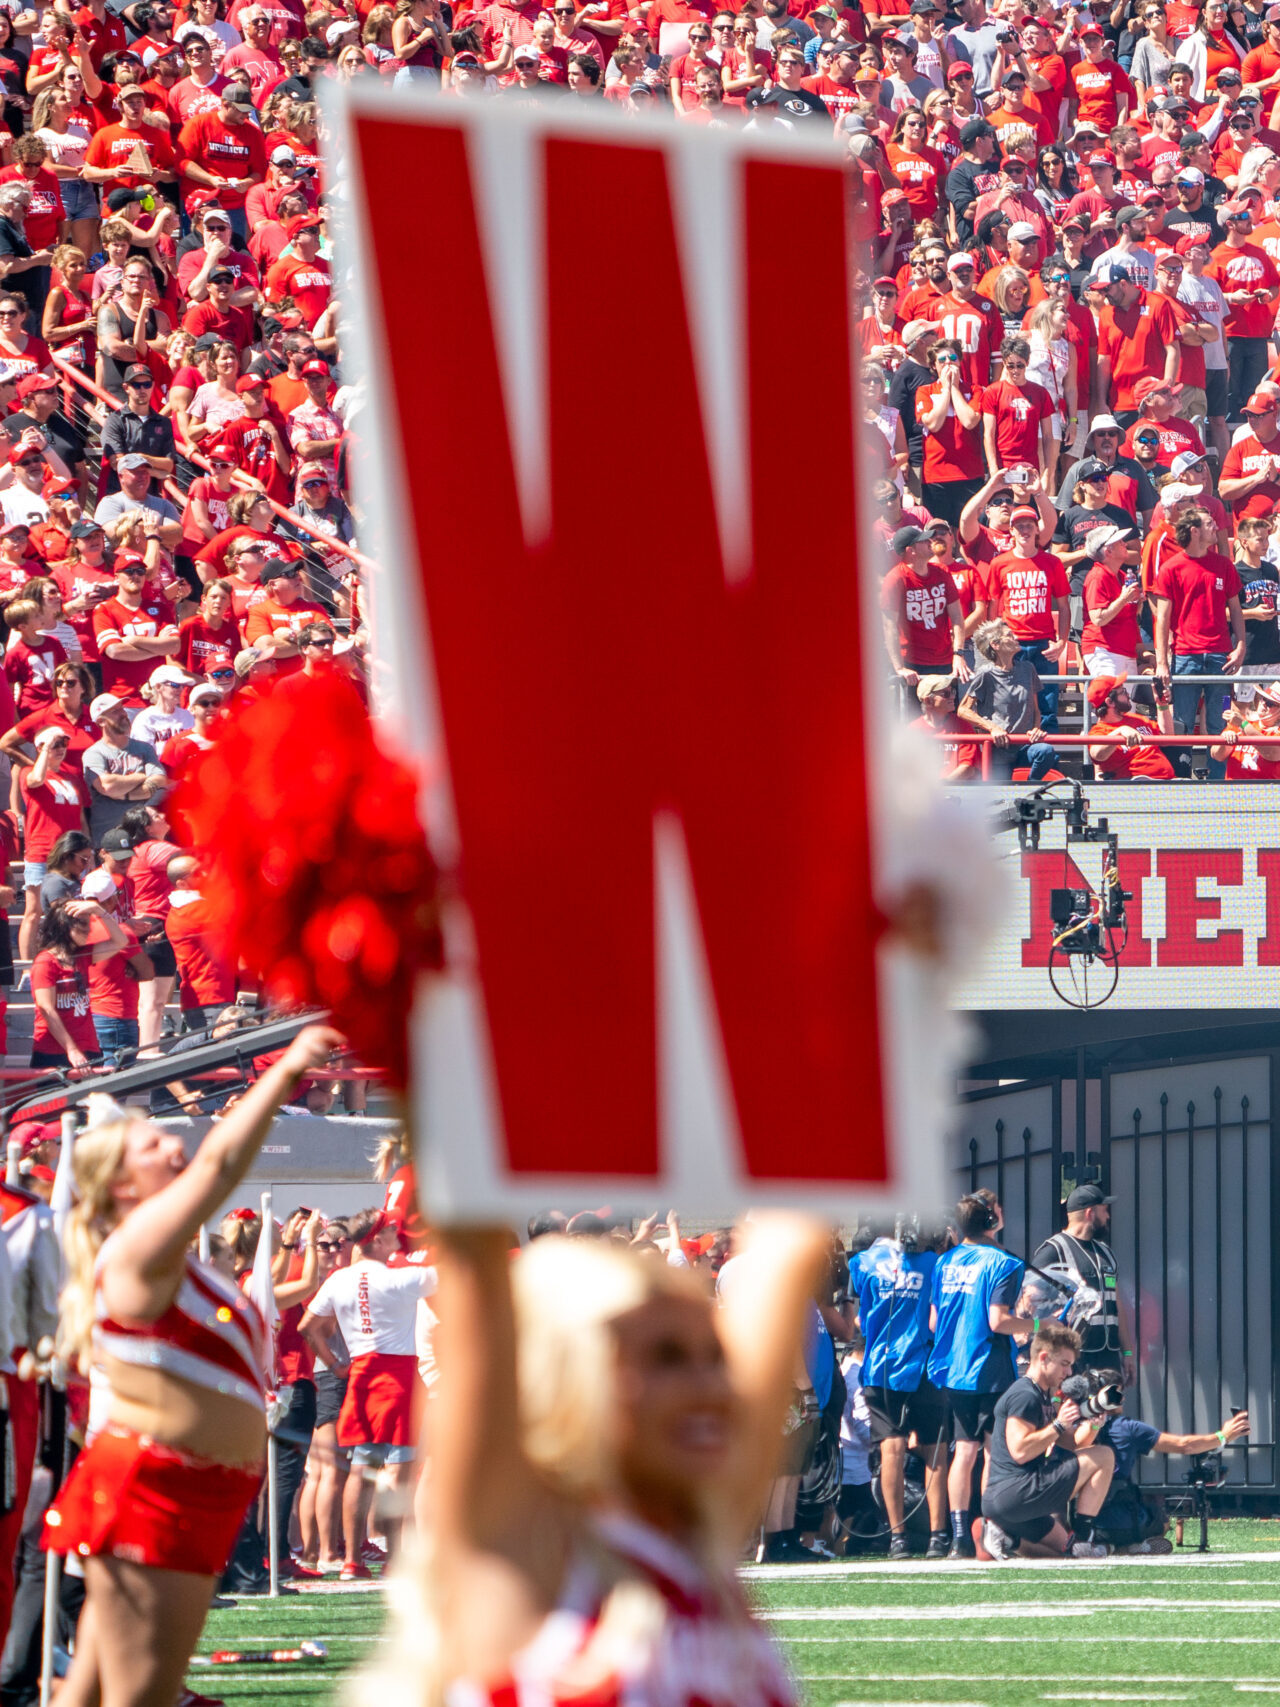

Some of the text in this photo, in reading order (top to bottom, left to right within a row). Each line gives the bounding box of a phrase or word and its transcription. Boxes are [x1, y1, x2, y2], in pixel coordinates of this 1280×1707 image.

[896, 161, 935, 175] NEBRASKA
[910, 171, 923, 182] N
[943, 313, 982, 353] 10
[1007, 571, 1048, 589] IOWA
[906, 583, 946, 602] SEA OF
[1009, 588, 1048, 599] HAS BAD
[906, 597, 947, 622] RED
[1009, 597, 1047, 616] CORN
[923, 612, 938, 631] N
[354, 113, 891, 1183] W
[46, 779, 80, 806] N
[358, 1272, 373, 1335] HUSKERS
